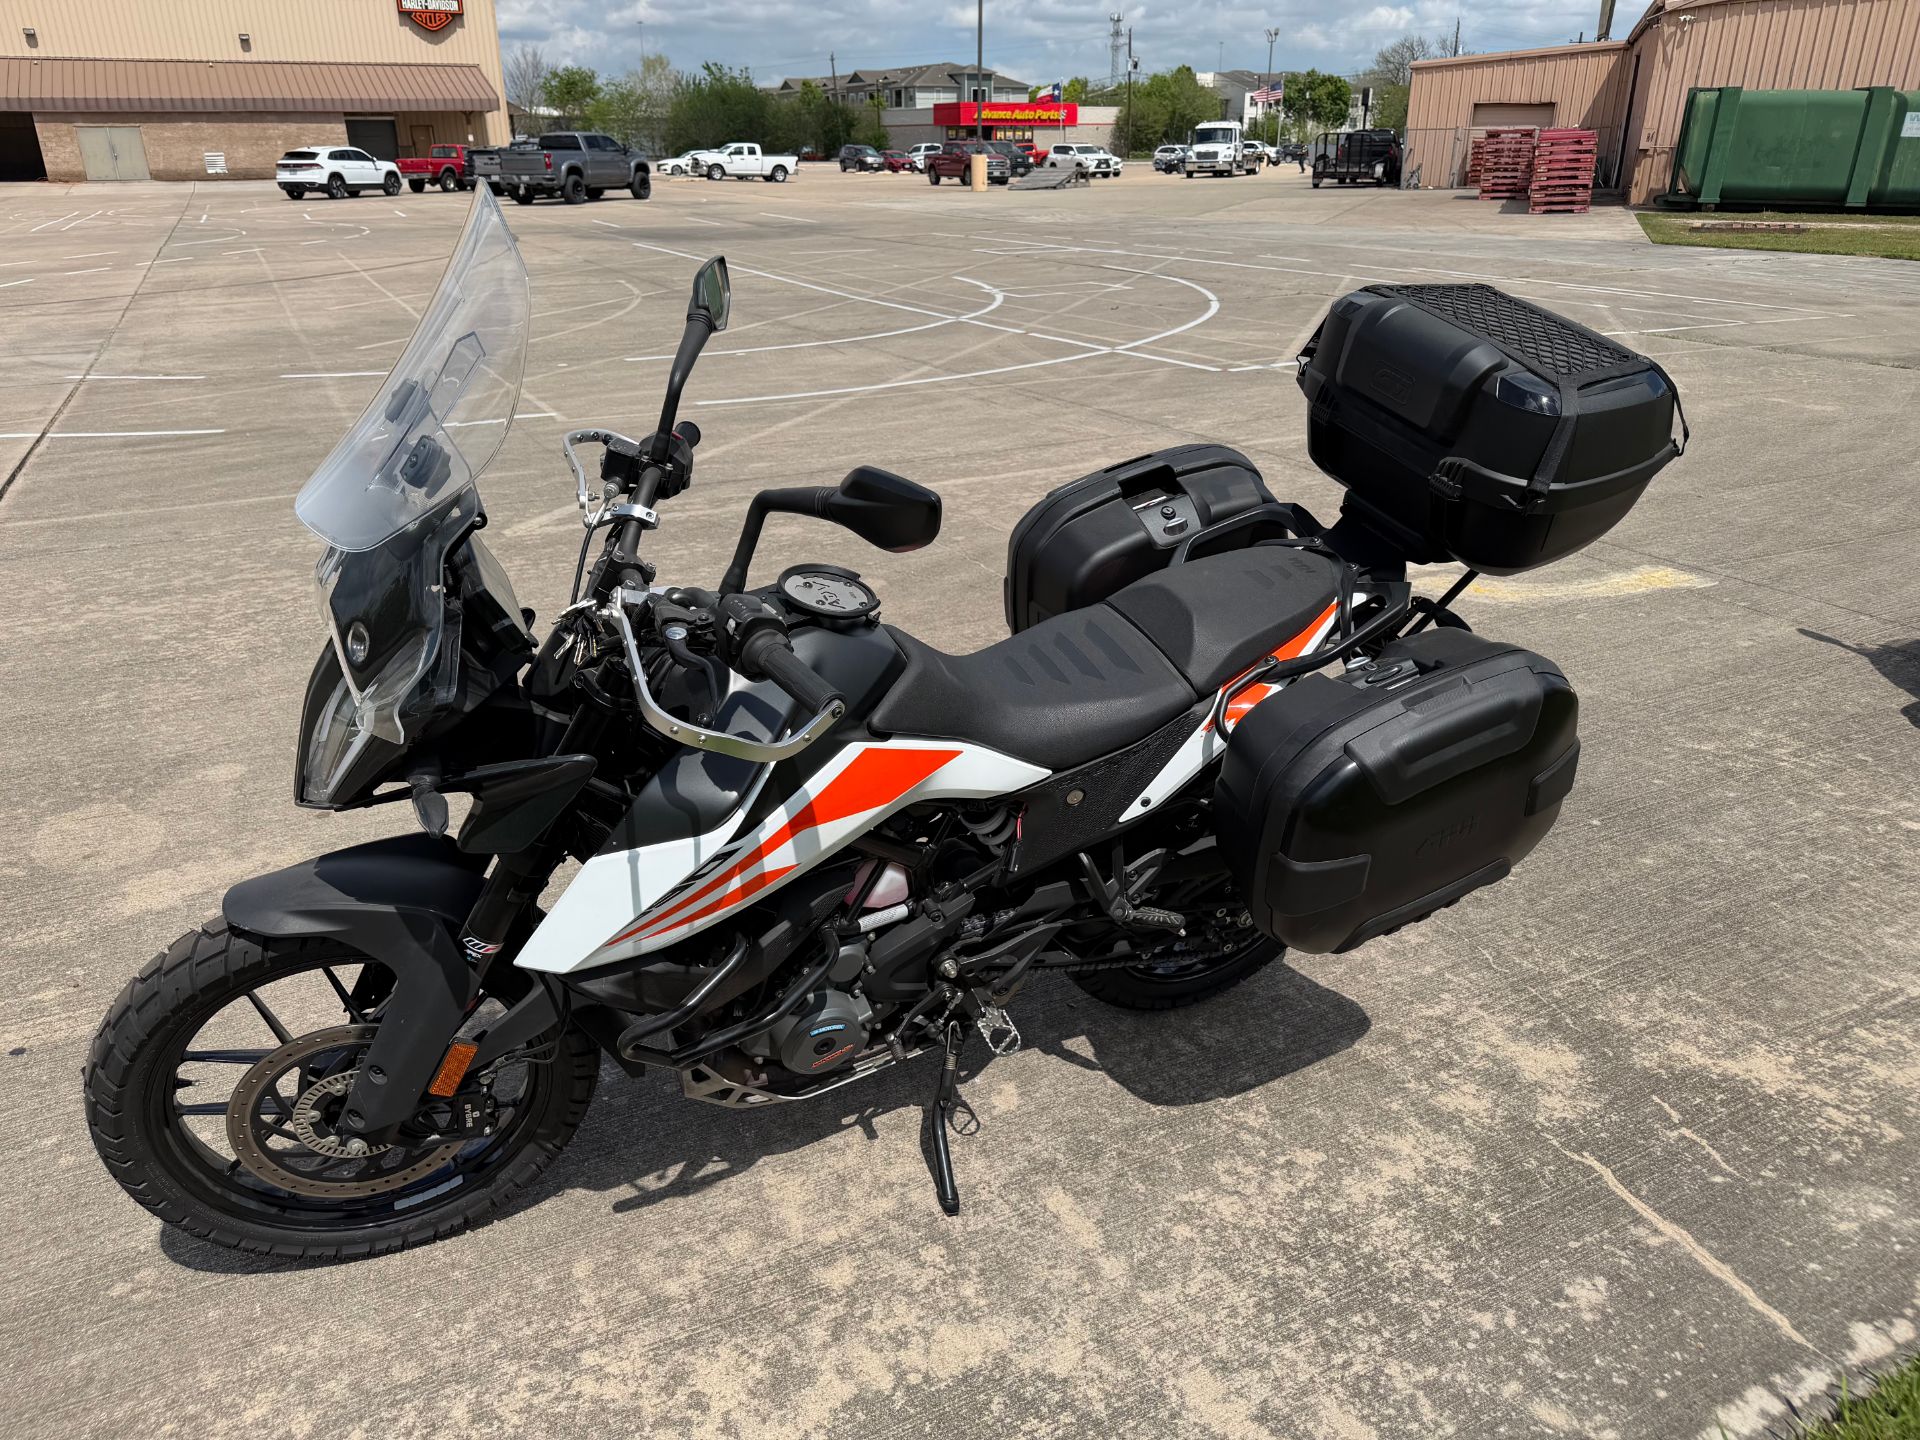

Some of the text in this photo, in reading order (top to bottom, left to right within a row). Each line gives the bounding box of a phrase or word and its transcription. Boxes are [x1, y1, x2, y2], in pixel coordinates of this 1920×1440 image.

[402, 0, 459, 11] HARLEY-DAVIDSON
[415, 12, 447, 27] CYCLES
[1013, 110, 1034, 119] Auto
[1035, 110, 1059, 119] Parts
[464, 1103, 474, 1128] BYBRE
